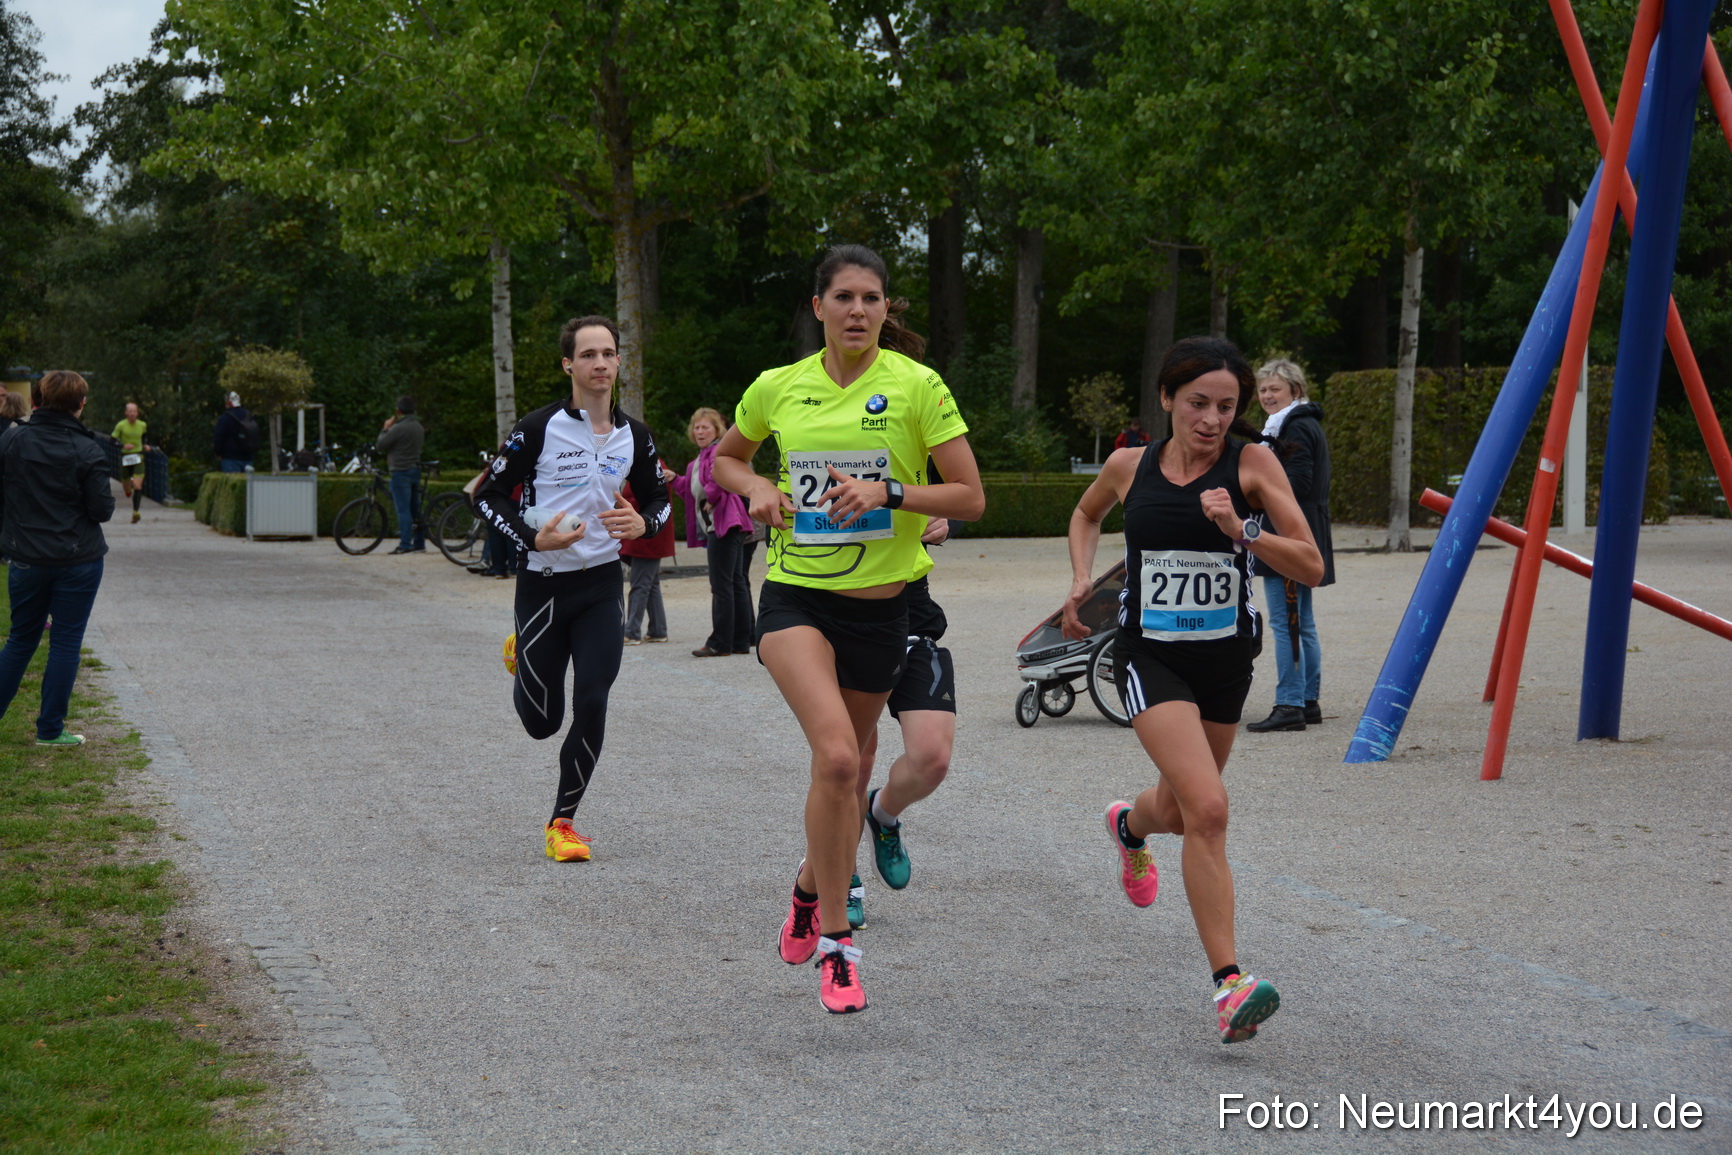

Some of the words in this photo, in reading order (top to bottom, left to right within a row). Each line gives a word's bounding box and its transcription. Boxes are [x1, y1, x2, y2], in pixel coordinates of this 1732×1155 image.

[861, 417, 887, 426] Partl
[790, 460, 823, 470] PARTL
[824, 459, 872, 469] Neumarkt
[799, 472, 881, 507] 247
[814, 516, 868, 530] Steie
[1144, 558, 1174, 568] PARTL
[1151, 572, 1232, 606] 2703
[1176, 615, 1205, 630] Inge
